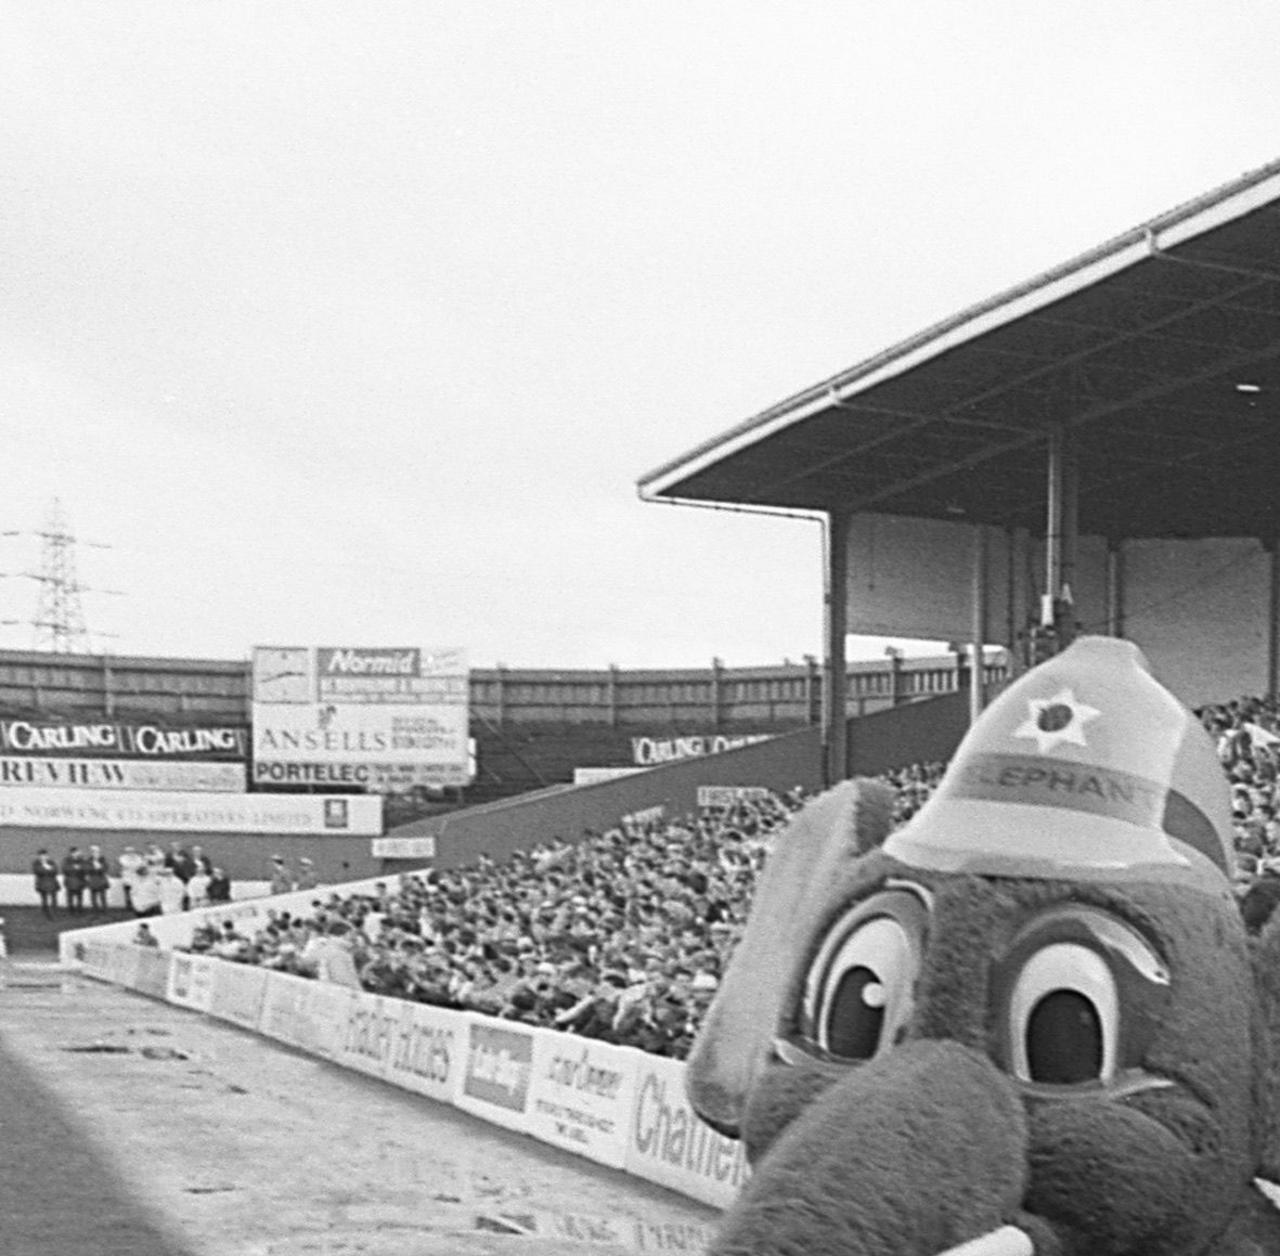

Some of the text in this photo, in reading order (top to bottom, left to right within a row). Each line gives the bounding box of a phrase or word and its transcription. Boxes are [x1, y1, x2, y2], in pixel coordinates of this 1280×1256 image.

[9, 721, 235, 753] CARLING CARLING
[257, 727, 386, 751] ANSELLS
[256, 762, 369, 782] PORTELEC
